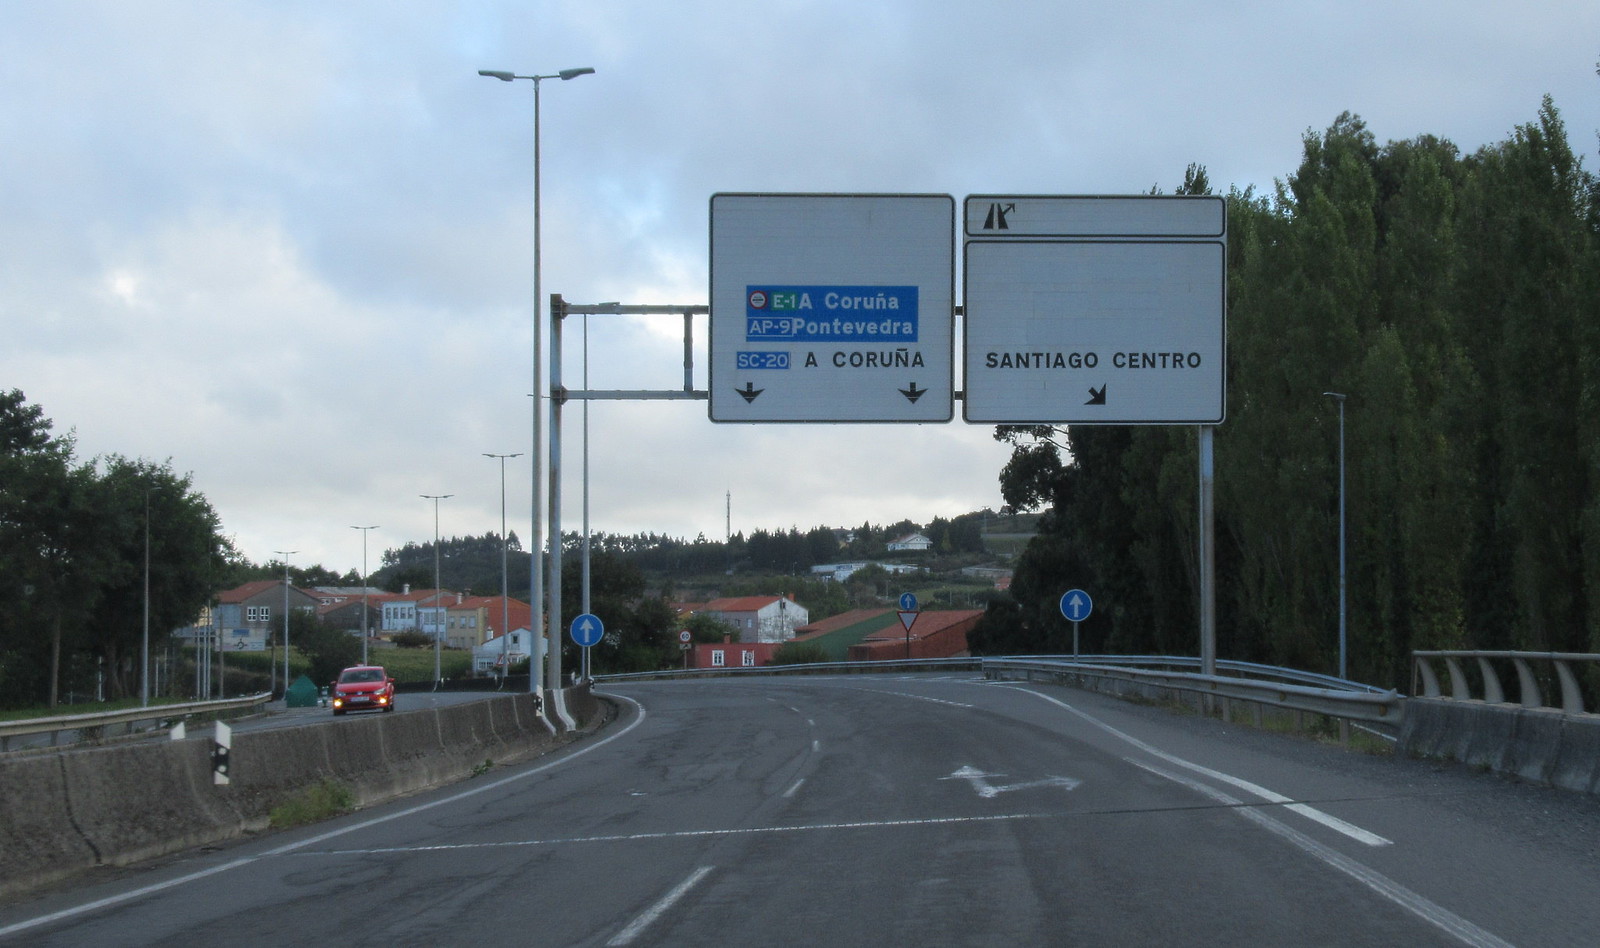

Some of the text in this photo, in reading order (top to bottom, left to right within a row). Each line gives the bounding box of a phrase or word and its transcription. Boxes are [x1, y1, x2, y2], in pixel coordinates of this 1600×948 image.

[773, 294, 796, 308] E-1
[799, 292, 899, 309] A Coruña
[750, 320, 791, 334] AP-9
[793, 318, 913, 335] Pontevedra
[738, 354, 788, 367] SC-20
[805, 348, 925, 367] A CORUÑA
[985, 352, 1201, 369] SANTIAGO CENTRO
